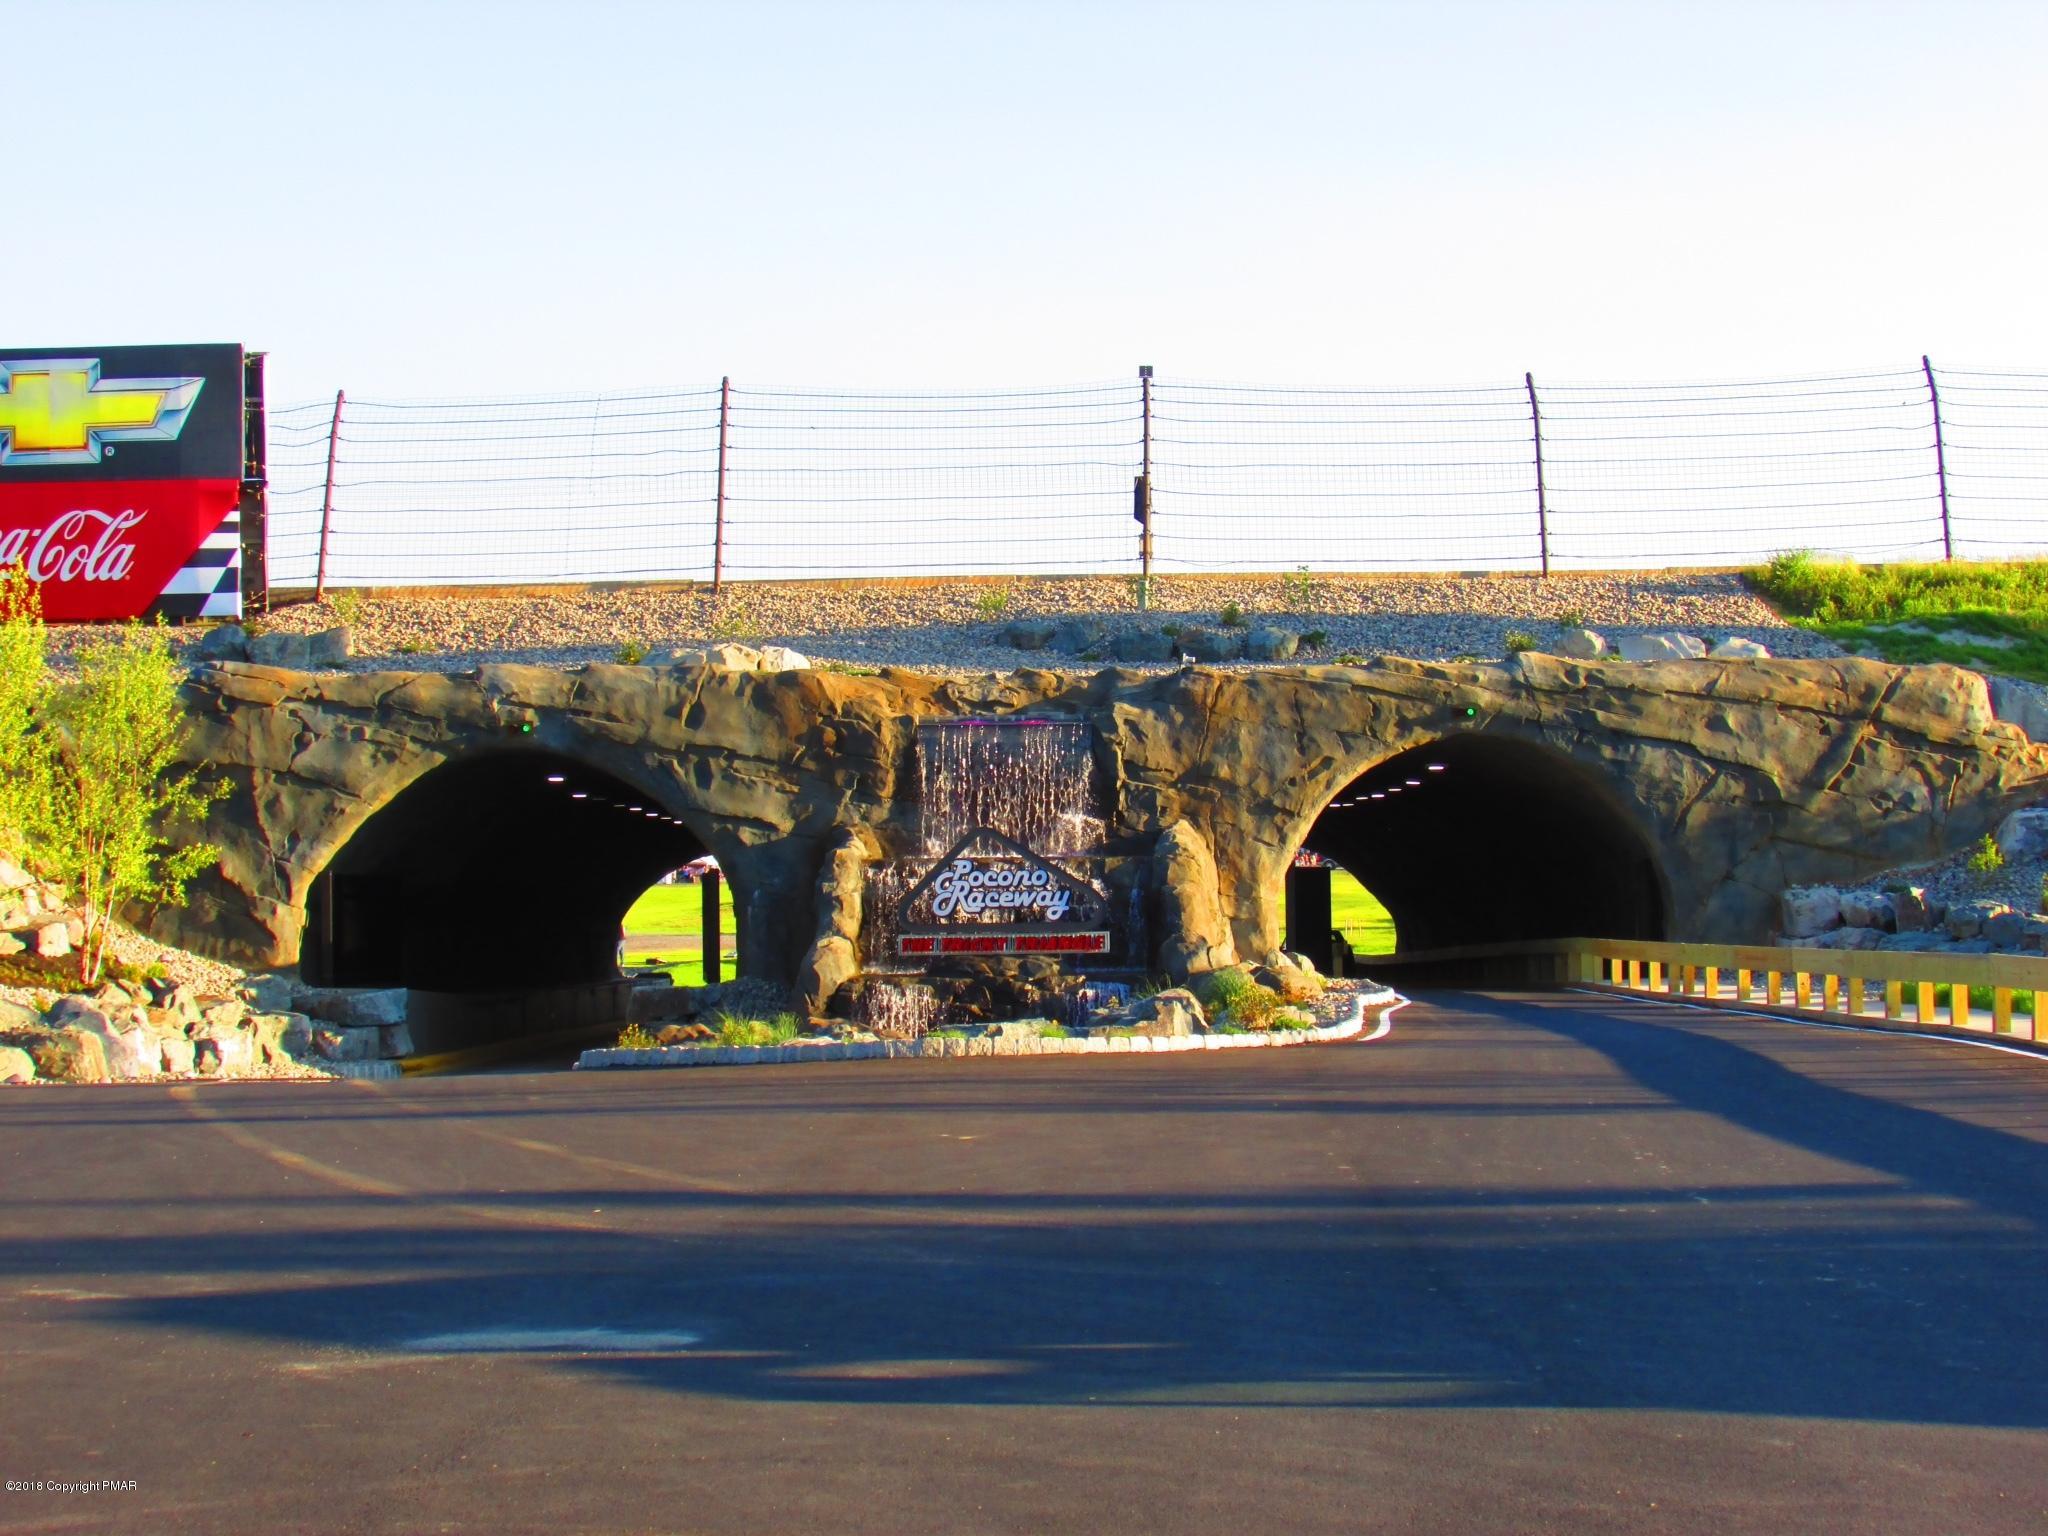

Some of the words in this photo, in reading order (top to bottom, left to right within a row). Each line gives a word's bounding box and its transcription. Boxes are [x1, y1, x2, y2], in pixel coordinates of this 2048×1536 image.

[0, 509, 149, 582] a-Cola
[934, 859, 1048, 893] Pocono
[932, 880, 1070, 920] Raceway
